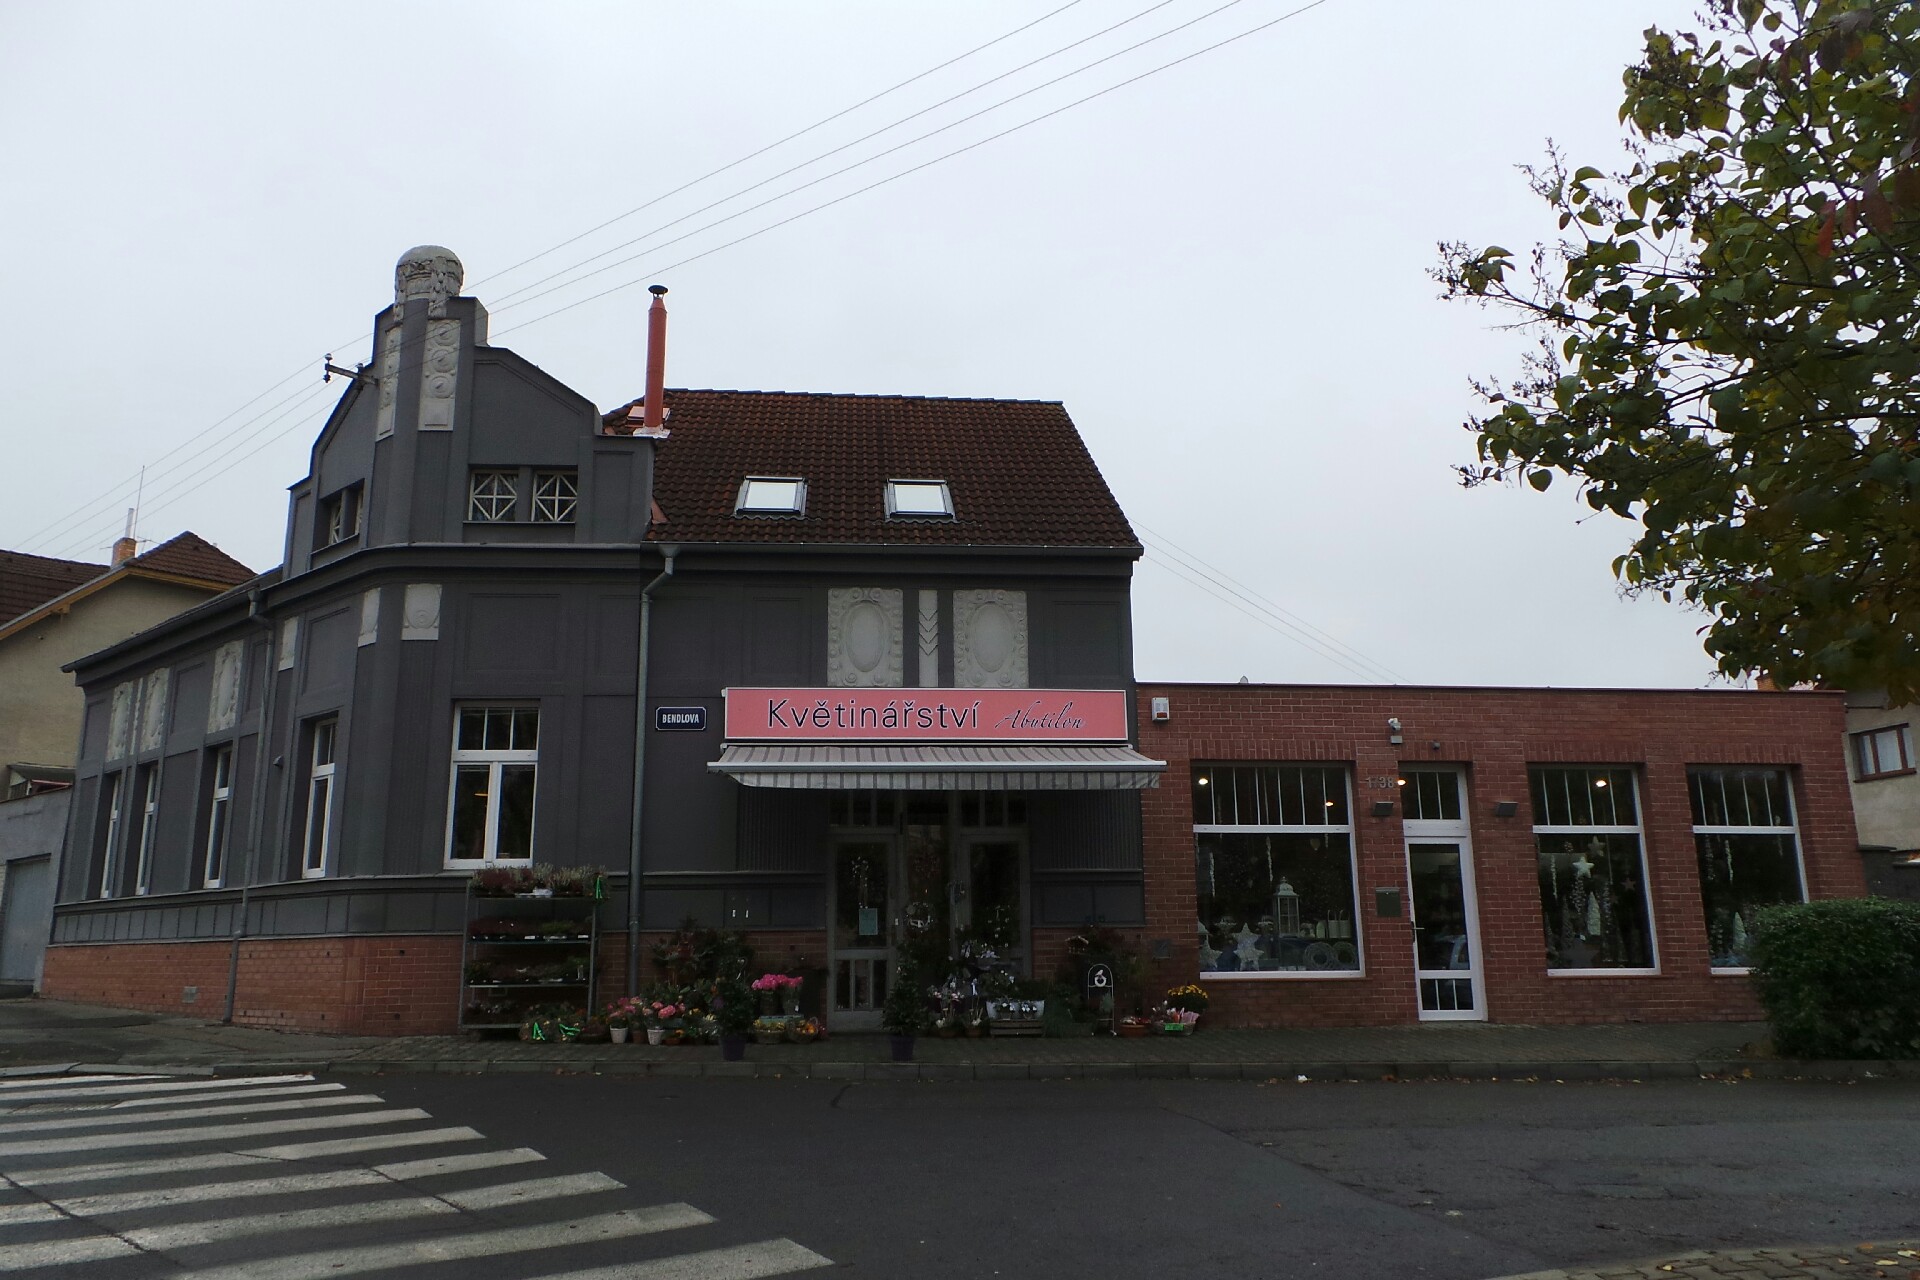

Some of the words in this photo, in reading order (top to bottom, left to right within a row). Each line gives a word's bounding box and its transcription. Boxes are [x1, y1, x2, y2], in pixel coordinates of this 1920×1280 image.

[662, 713, 700, 724] BENDLOVA
[768, 699, 981, 728] Květinářství
[995, 700, 1083, 729] Abutilon
